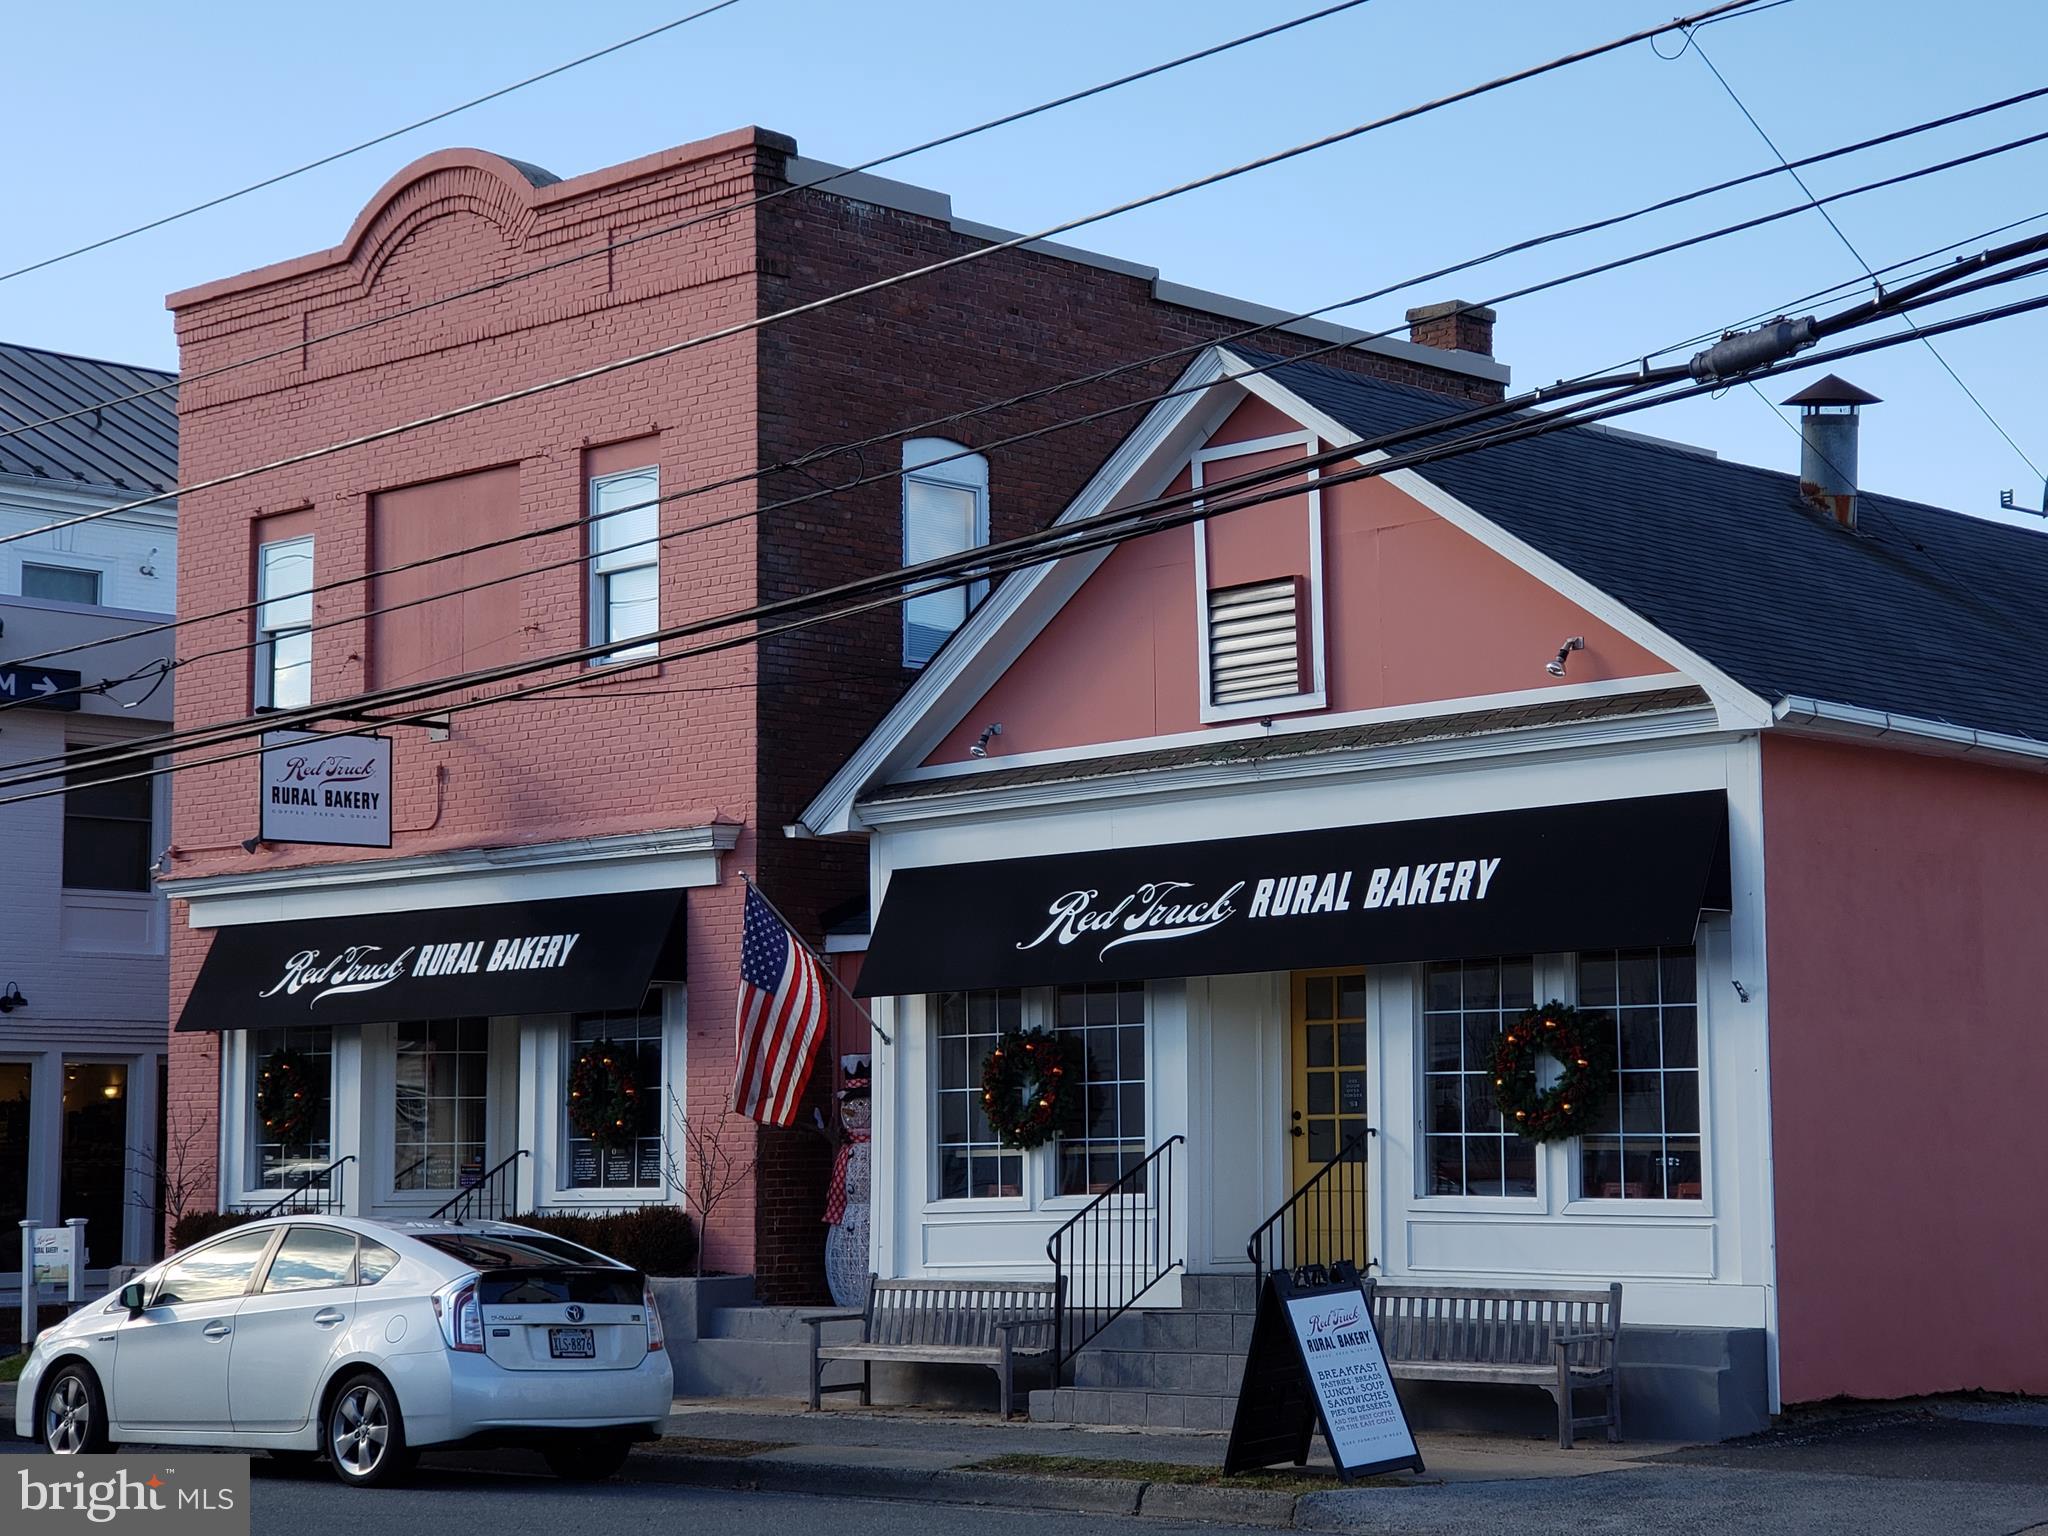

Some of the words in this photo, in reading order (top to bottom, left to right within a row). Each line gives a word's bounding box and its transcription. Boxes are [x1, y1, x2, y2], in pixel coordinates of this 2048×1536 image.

[276, 756, 326, 783] Red
[318, 755, 377, 790] Truck
[271, 785, 318, 807] RURAL
[324, 789, 380, 810] BAKERY
[1015, 888, 1135, 950] Red
[1099, 879, 1246, 963] Truck
[1248, 871, 1352, 918] RURAL
[1362, 857, 1501, 909] BAKERY
[259, 950, 345, 997] Red
[310, 945, 416, 1010] Truck
[411, 940, 485, 977] RURAL
[486, 933, 581, 972] BAKERY
[1307, 1311, 1332, 1336] Red
[1331, 1305, 1360, 1334] Truck
[1306, 1335, 1336, 1353] RURAL
[1337, 1330, 1372, 1348] BAKERY
[1317, 1362, 1378, 1381] BREAKFAST
[1320, 1378, 1352, 1389] PASTRIES
[1354, 1372, 1382, 1384] BREADS
[1323, 1385, 1356, 1399] LUNCH
[1360, 1380, 1386, 1392] SOUP
[1327, 1390, 1389, 1409] SANDWICHES
[1330, 1408, 1346, 1418] PIES
[1357, 1400, 1393, 1413] DESSERTS
[1334, 1417, 1347, 1425] AND
[1347, 1415, 1358, 1423] THE
[1360, 1419, 1375, 1428] EAST
[1376, 1416, 1397, 1425] COAST
